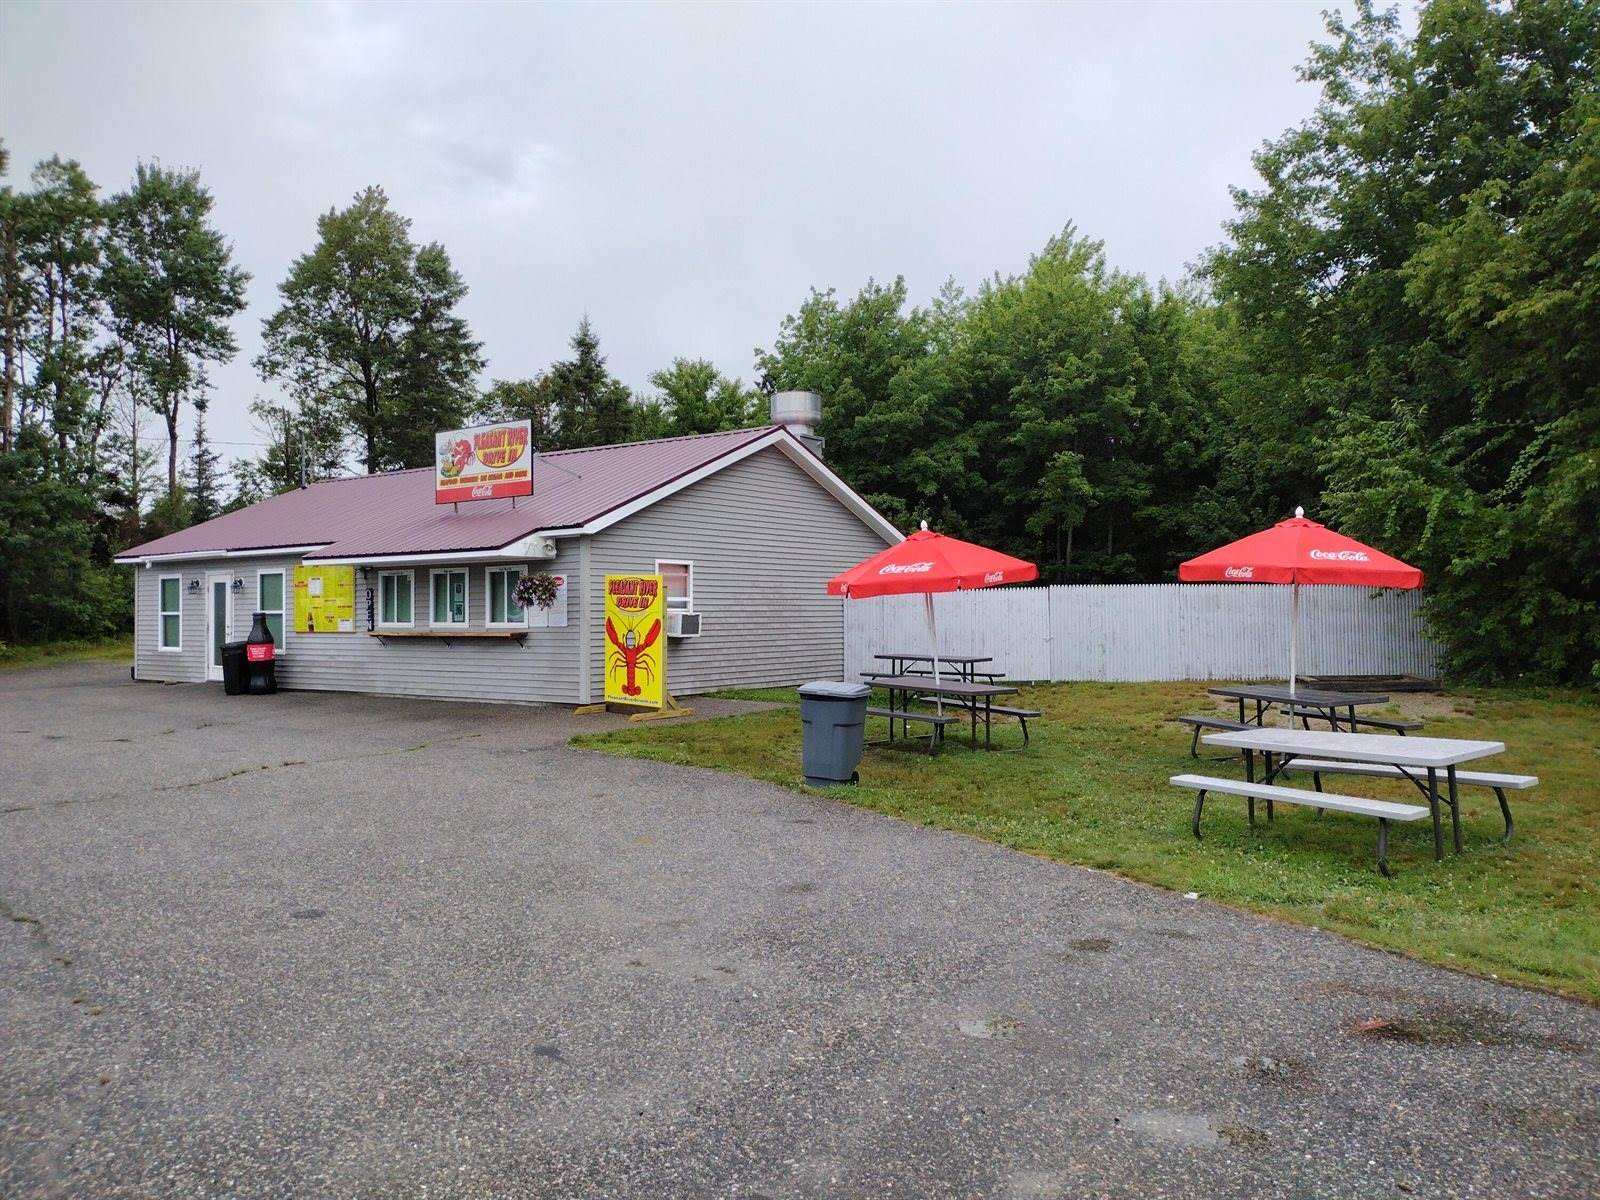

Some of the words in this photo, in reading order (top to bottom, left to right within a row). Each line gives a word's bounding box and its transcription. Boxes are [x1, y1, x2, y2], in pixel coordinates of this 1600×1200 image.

[474, 431, 505, 450] PLEASANT
[507, 426, 528, 446] RIVER
[483, 449, 505, 465] DRIVE
[608, 579, 638, 596] PLEASANT
[638, 579, 658, 598] RIVER
[616, 596, 638, 609] DRIVE
[639, 596, 650, 609] IN
